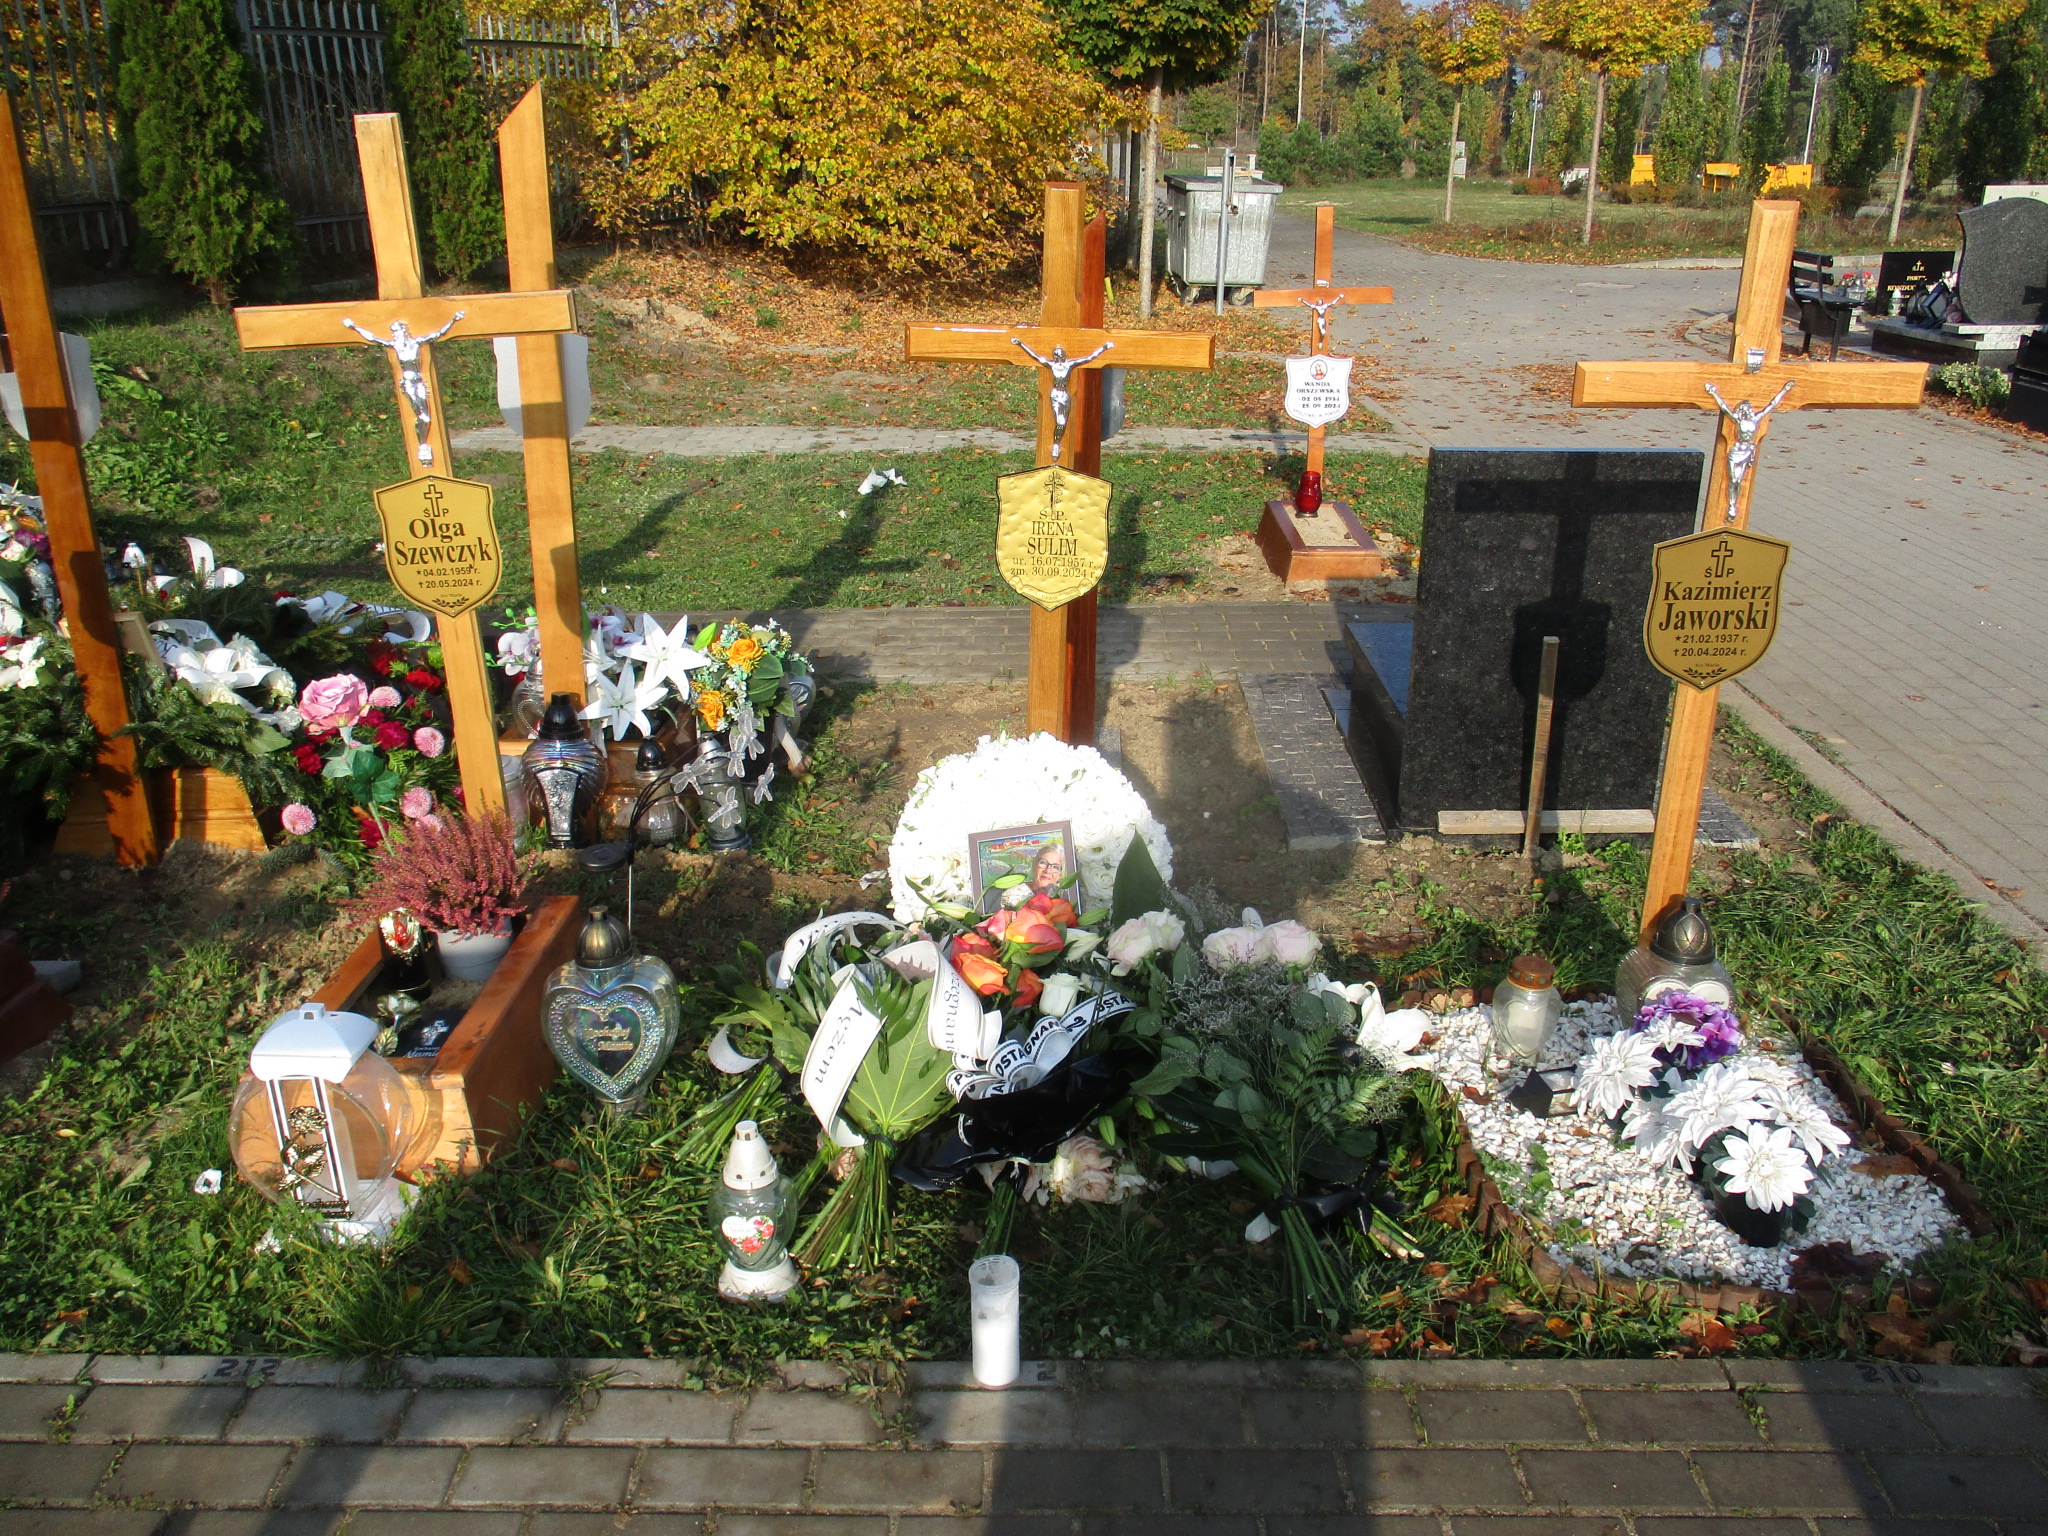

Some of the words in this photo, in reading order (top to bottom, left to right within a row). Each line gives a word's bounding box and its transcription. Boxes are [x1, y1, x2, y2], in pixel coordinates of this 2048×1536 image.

[409, 518, 466, 544] Olga
[1030, 520, 1075, 537] IRENA
[394, 537, 493, 569] Szewczyk
[1026, 536, 1079, 557] SULIM
[1012, 556, 1027, 566] ur.
[1030, 556, 1086, 568] 16.07.1957
[423, 567, 472, 577] 04.02.1959
[1010, 567, 1028, 577] zm.
[1031, 566, 1087, 579] 30.09.2024
[425, 578, 474, 589] 20.05.2024
[1662, 580, 1773, 602] Kazimierz
[1658, 601, 1770, 632] Jaworski
[1682, 634, 1740, 644] 21.02.1937
[1680, 647, 1737, 657] 20.04.2024
